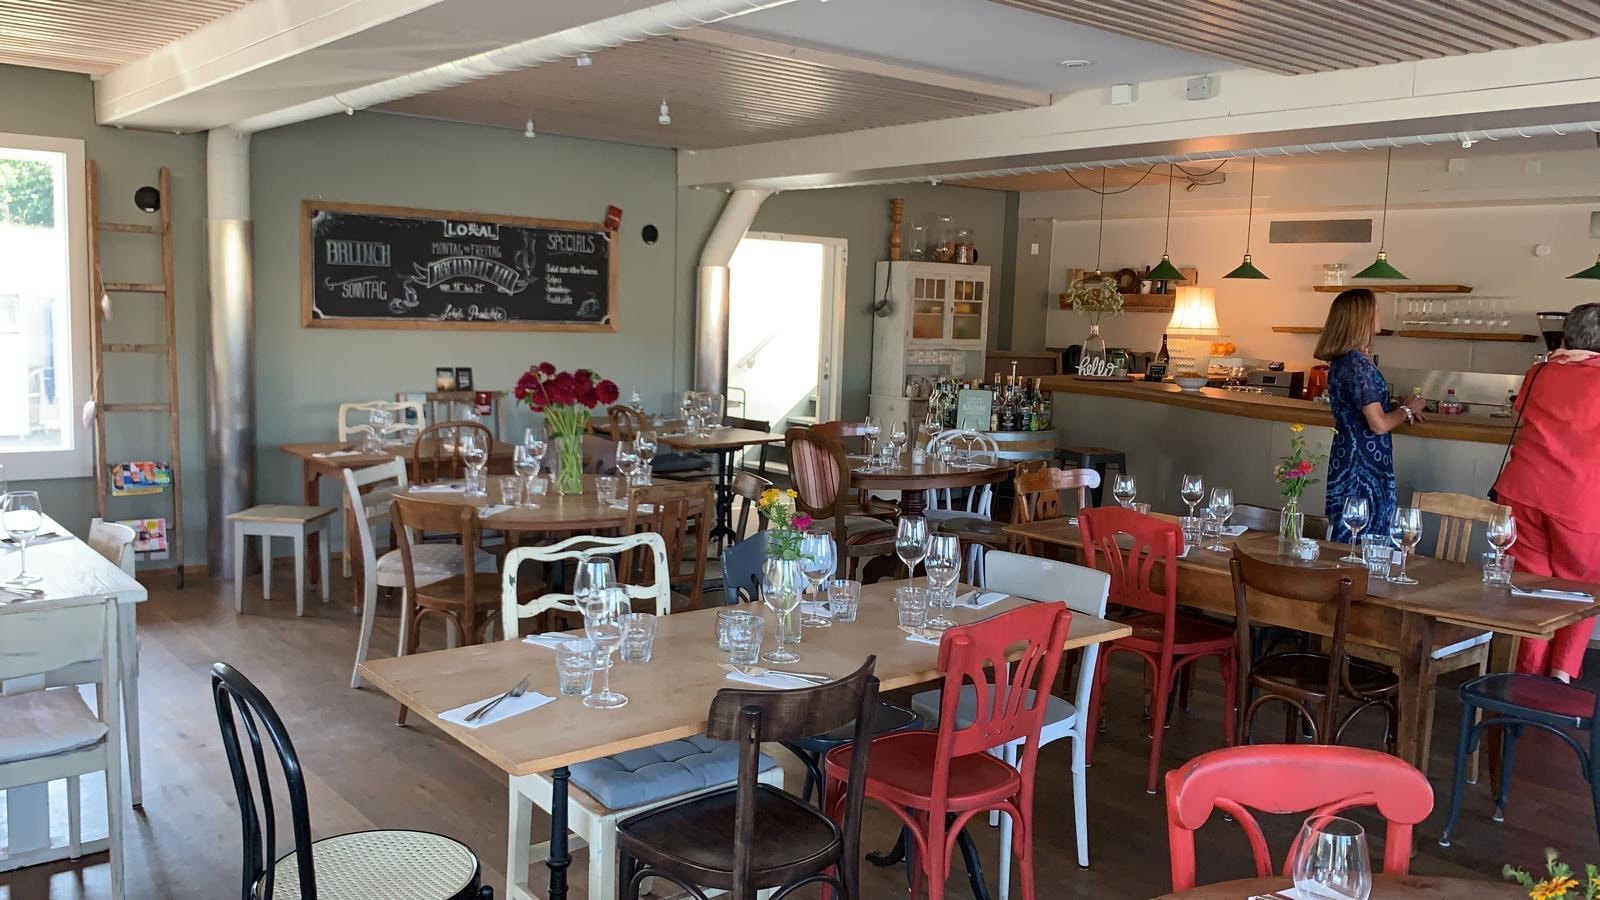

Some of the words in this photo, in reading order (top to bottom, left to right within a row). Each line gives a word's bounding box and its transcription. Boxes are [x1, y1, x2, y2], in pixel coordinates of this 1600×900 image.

[325, 240, 391, 267] BRUNCH
[432, 241, 464, 256] MONTAG
[470, 243, 502, 258] FREITAG
[546, 233, 596, 254] SPECIALS
[342, 280, 388, 300] SONNTAG
[1075, 356, 1119, 377] hello
